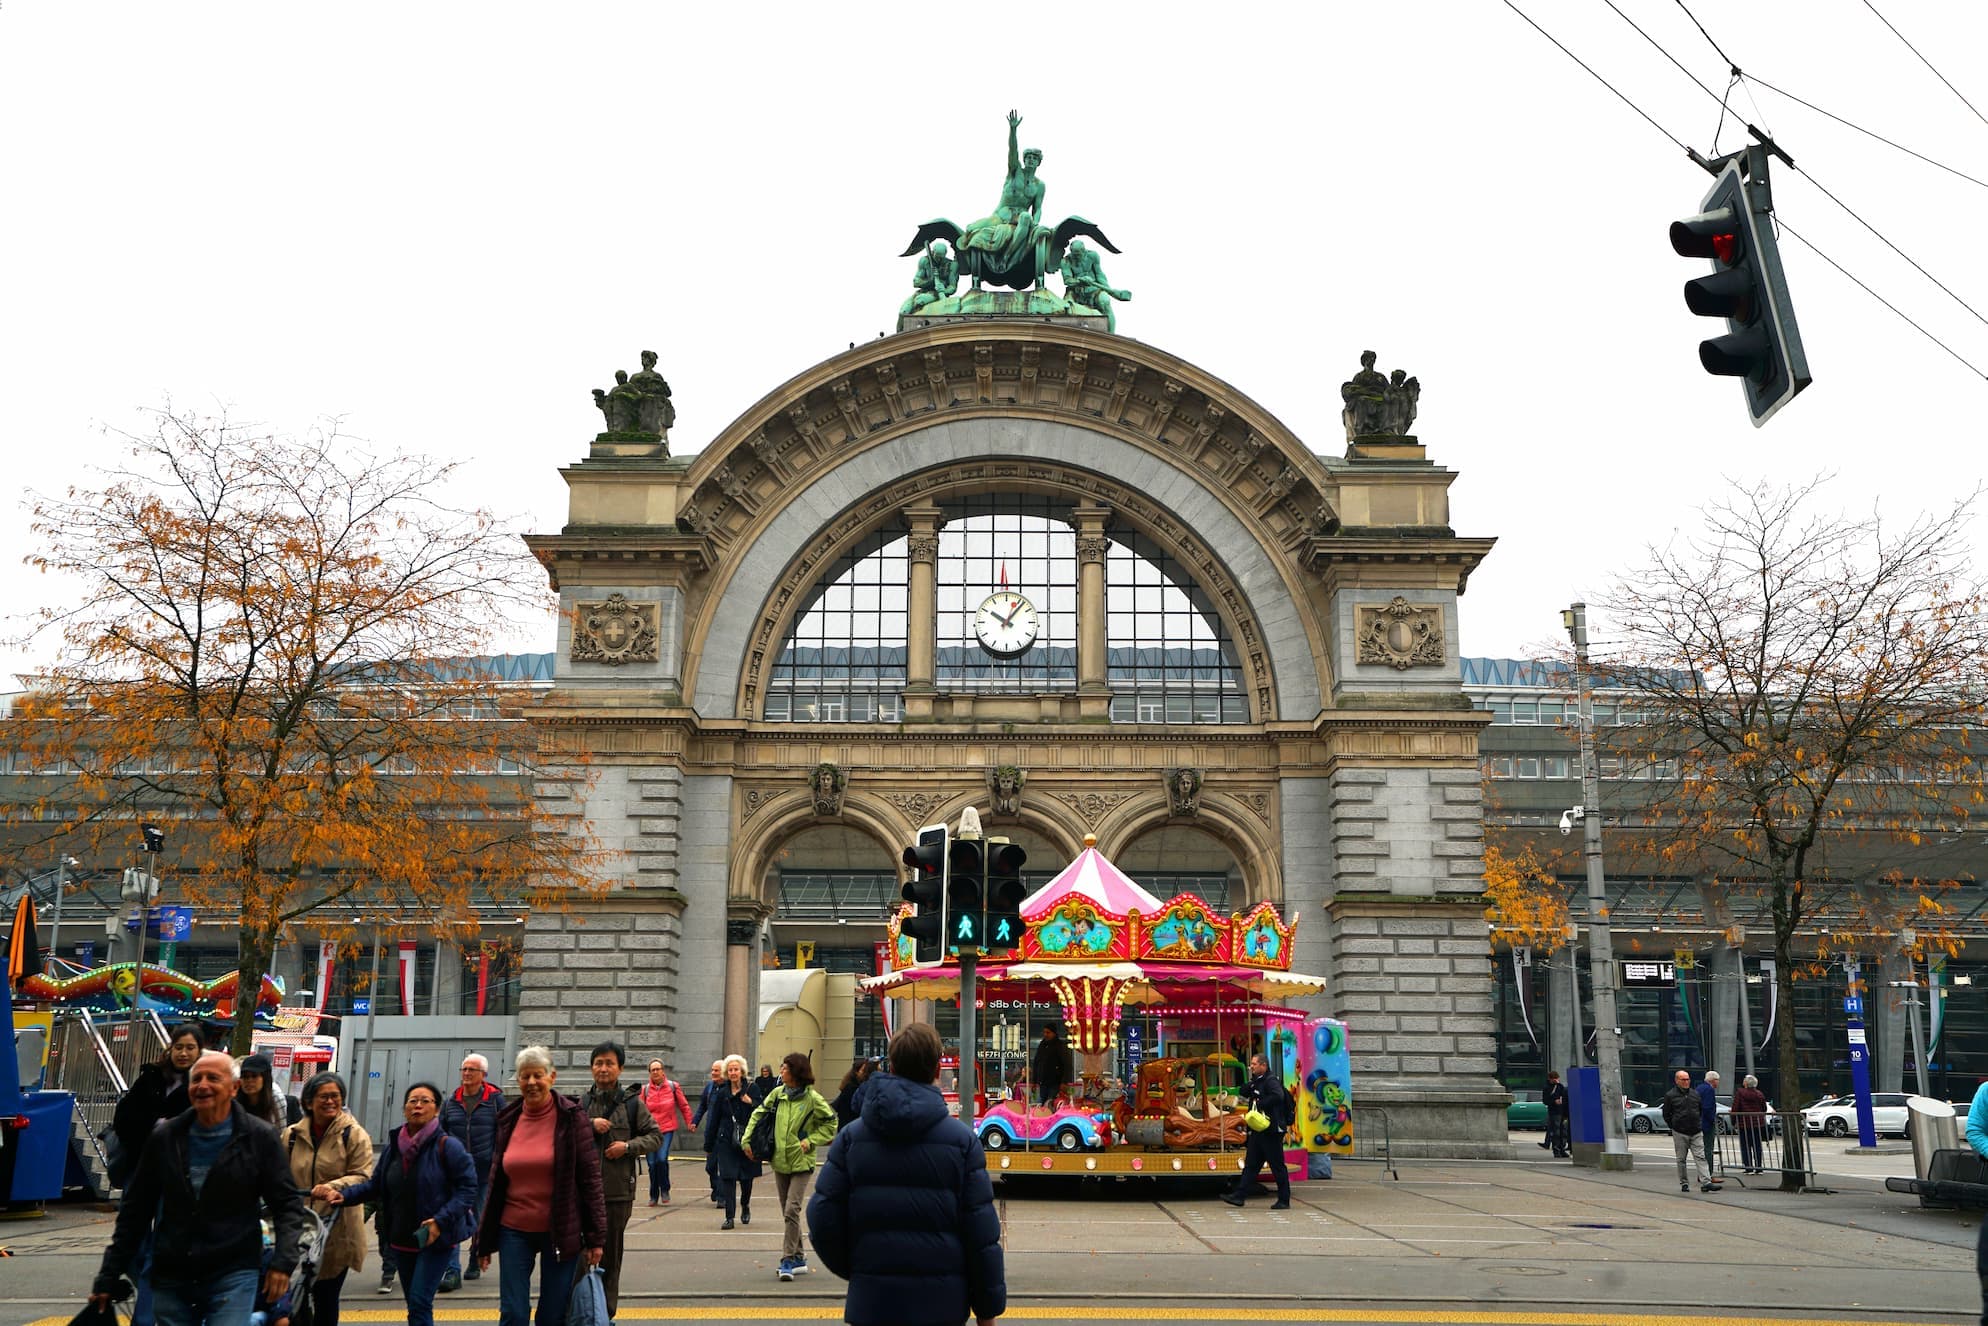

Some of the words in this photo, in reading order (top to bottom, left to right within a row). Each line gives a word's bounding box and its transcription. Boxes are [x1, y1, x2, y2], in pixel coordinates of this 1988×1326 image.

[353, 1001, 367, 1010] WC
[989, 1000, 1010, 1009] SBB
[1847, 1000, 1857, 1010] H
[1850, 1050, 1861, 1058] 10
